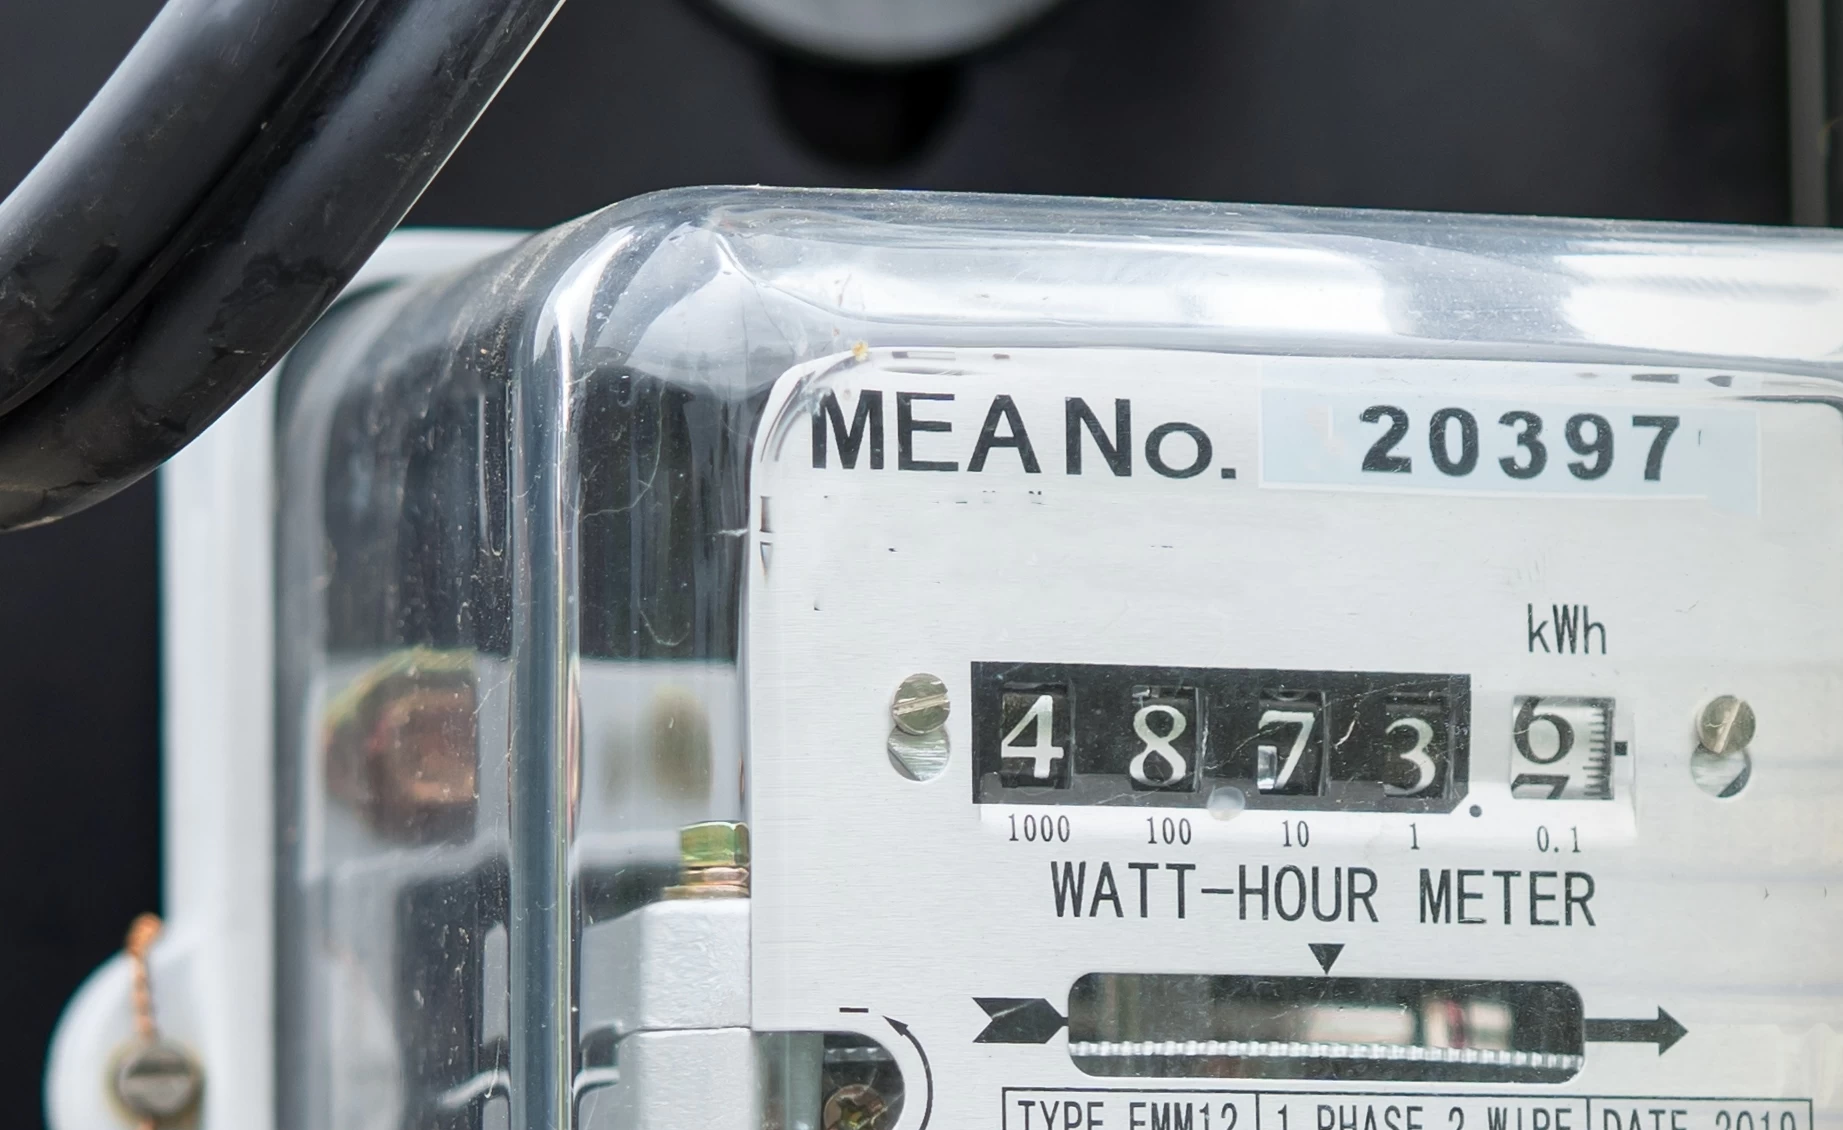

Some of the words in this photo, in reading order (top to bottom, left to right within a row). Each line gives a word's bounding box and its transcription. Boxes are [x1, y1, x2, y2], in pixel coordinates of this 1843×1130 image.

[811, 389, 1042, 474] MEA
[1065, 397, 1237, 480] No.
[1359, 405, 1680, 481] 20397
[1527, 603, 1606, 655] kWh
[1009, 814, 1070, 843] 1000
[1147, 817, 1192, 846] 100
[1283, 820, 1310, 848] 10
[1410, 823, 1420, 851] 1
[1536, 826, 1582, 854] 0.1
[1050, 861, 1379, 923] WATT-HOUR
[1419, 868, 1596, 927] METER
